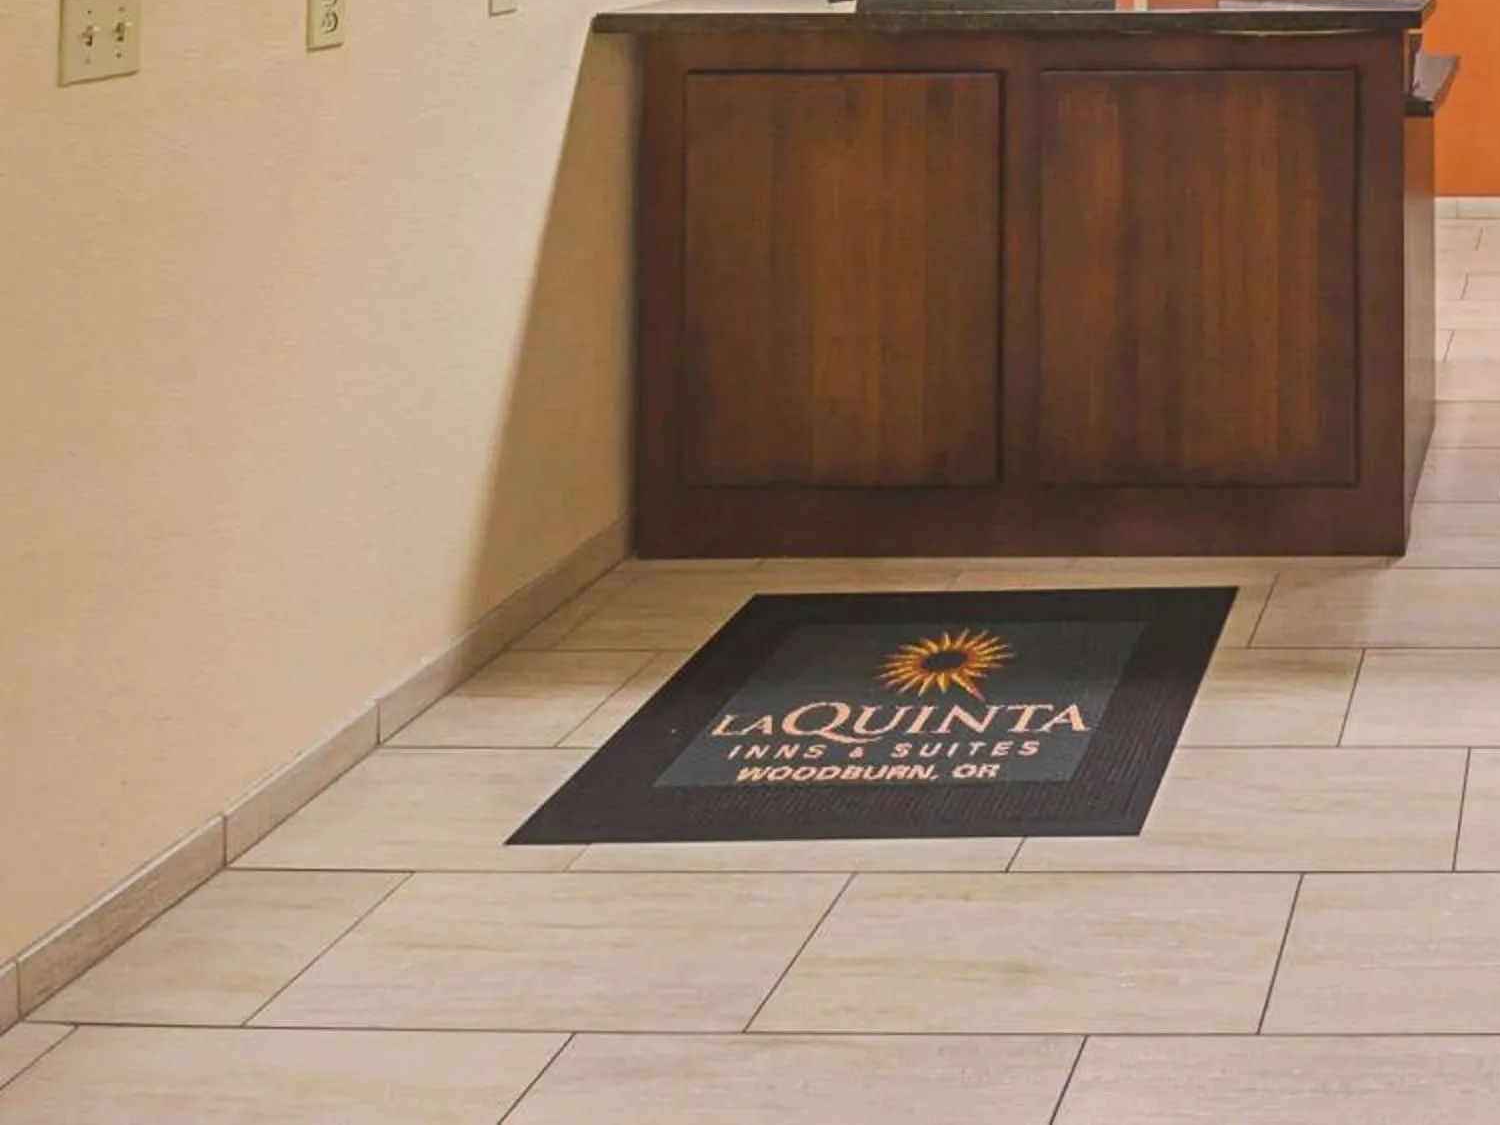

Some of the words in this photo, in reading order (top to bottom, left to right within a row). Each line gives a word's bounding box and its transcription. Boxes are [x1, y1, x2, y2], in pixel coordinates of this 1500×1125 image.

[727, 744, 825, 760] INNS
[849, 746, 864, 759] &
[889, 740, 1041, 758] SUITES
[952, 762, 1000, 779] OR
